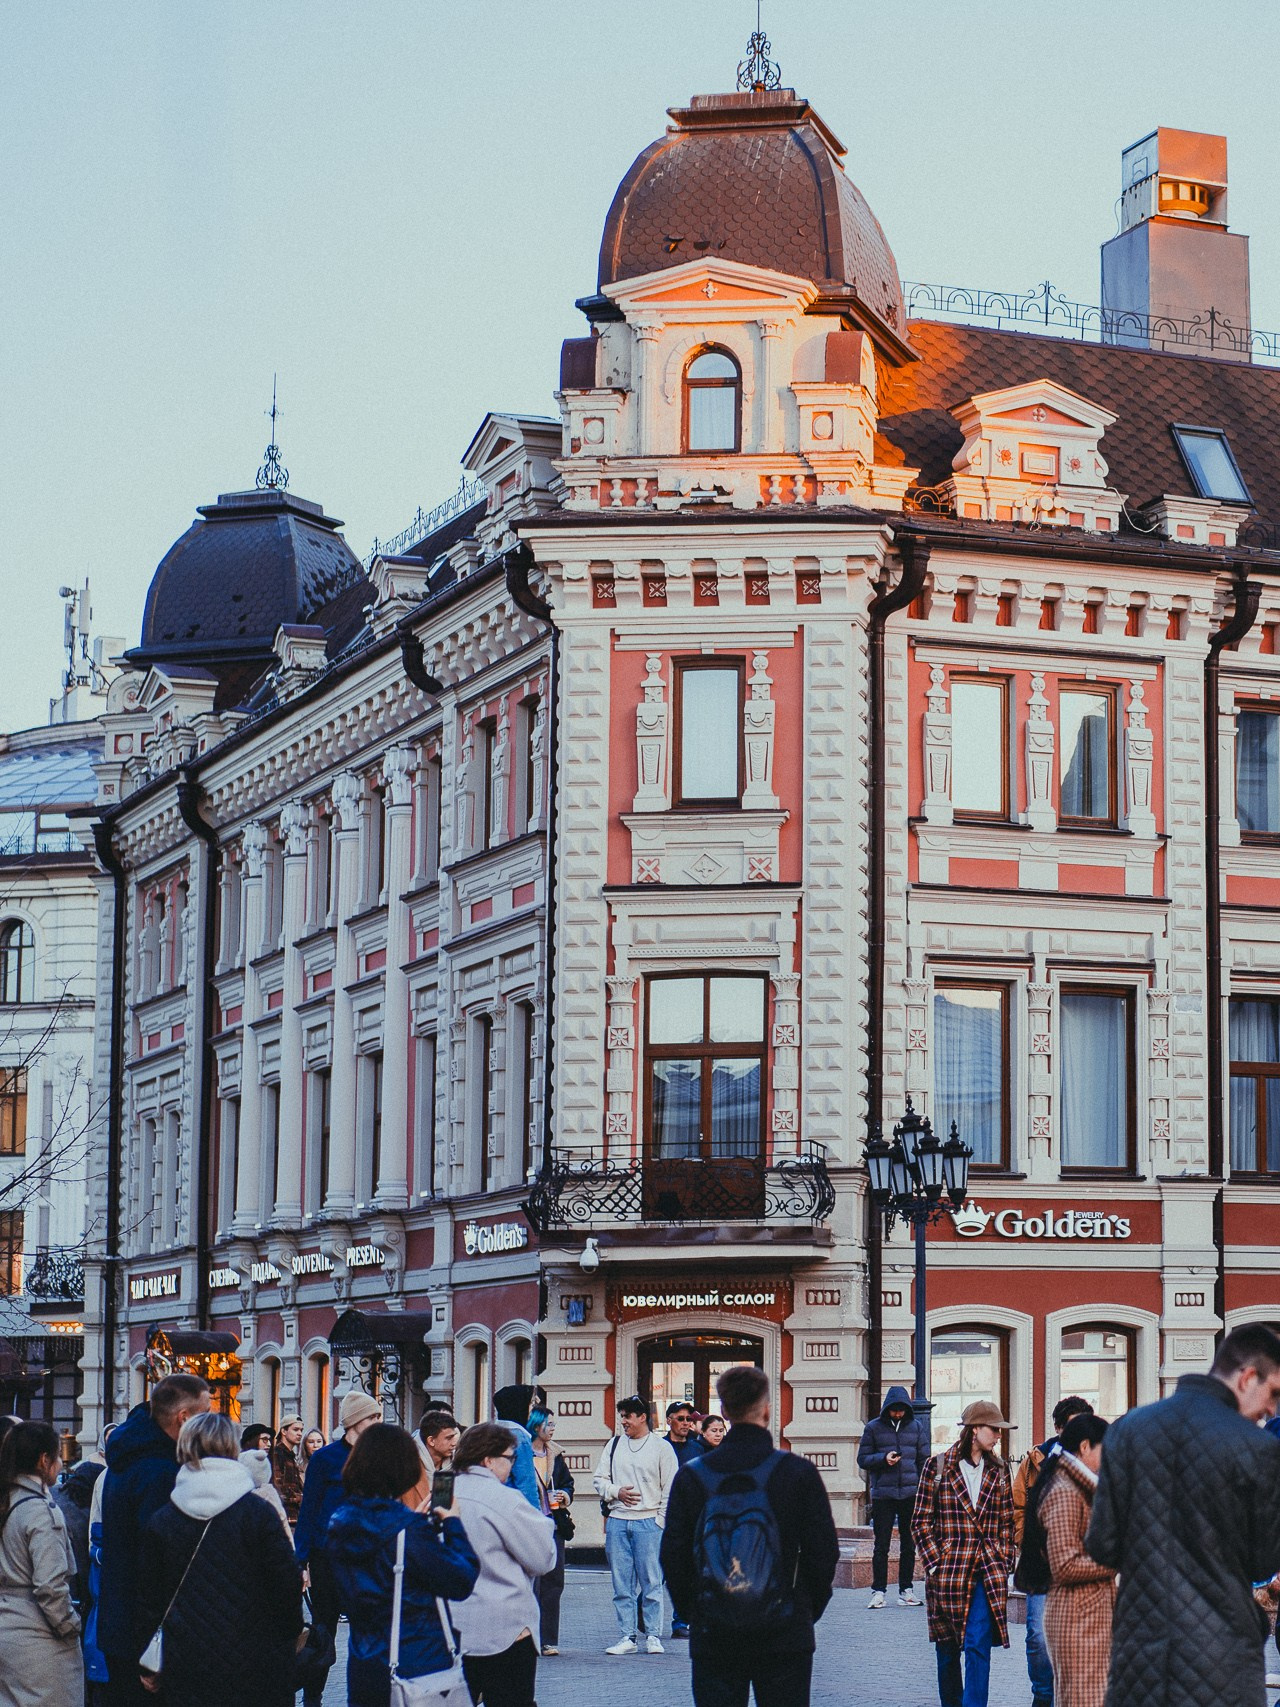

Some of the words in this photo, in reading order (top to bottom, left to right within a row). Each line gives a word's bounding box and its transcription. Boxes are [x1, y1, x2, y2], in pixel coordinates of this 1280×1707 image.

[994, 1209, 1131, 1238] Golden's
[1073, 1211, 1104, 1219] JEWELRY
[478, 1223, 524, 1254] Golden's
[622, 1289, 719, 1309] ювелирный
[723, 1292, 775, 1305] салон
